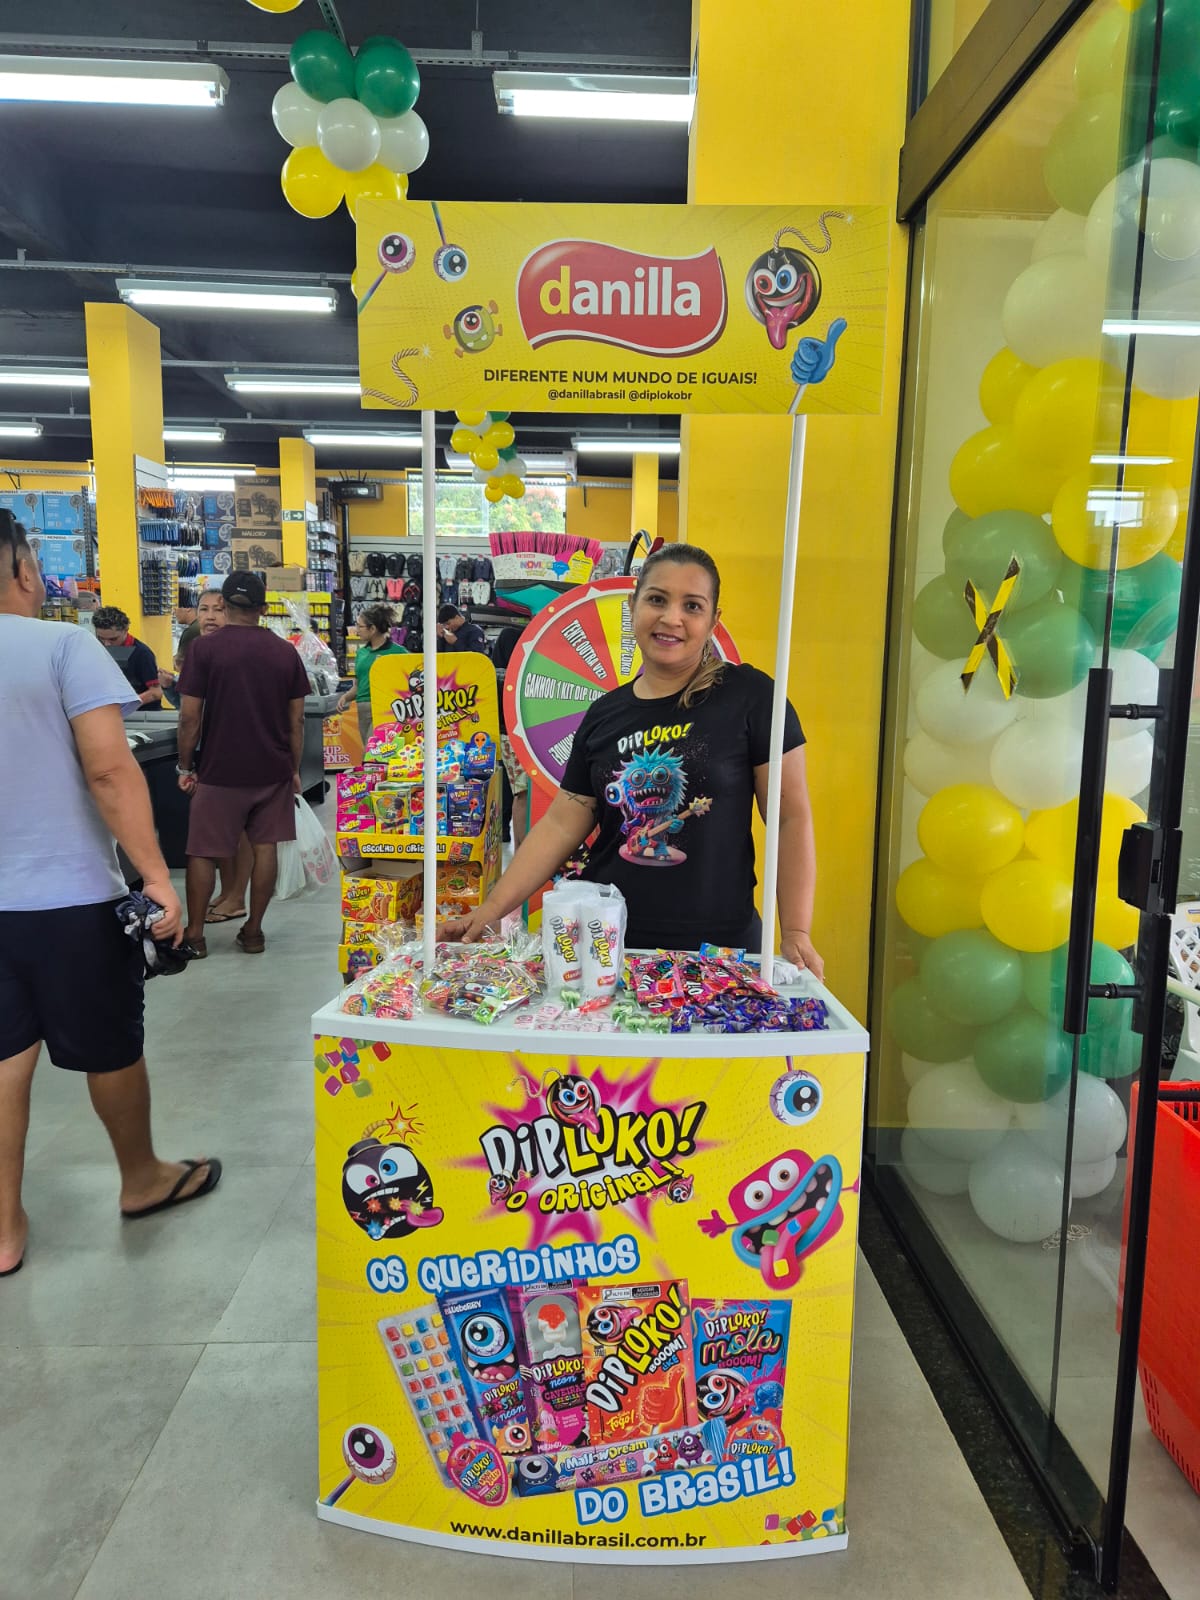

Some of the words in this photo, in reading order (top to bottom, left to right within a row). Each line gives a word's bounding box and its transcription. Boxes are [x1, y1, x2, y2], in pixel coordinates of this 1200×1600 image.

[539, 264, 701, 317] danilla
[483, 368, 568, 383] DIFERENTE
[572, 370, 609, 384] NUM
[612, 371, 673, 385] MUNDO
[676, 372, 698, 385] DE
[701, 371, 758, 385] IGUAIS!
[547, 388, 626, 401] @danillabrasil
[628, 389, 693, 403] @diplokobr
[560, 618, 586, 648] TENTE
[576, 639, 598, 669] OUTRA
[593, 661, 608, 681] VEZ!
[524, 672, 557, 699] GANHOU
[556, 680, 562, 699] 1
[561, 681, 575, 700] KIT
[574, 685, 588, 701] DIP
[617, 722, 692, 754] DiPLOKO!
[506, 1189, 528, 1212] O
[368, 1259, 407, 1291] OS
[704, 1309, 768, 1338] DiPLOKO!
[586, 1284, 689, 1413] DiPLOKO!
[578, 1490, 627, 1525] DO
[449, 1520, 707, 1548] www.danillabrasil.com.br
